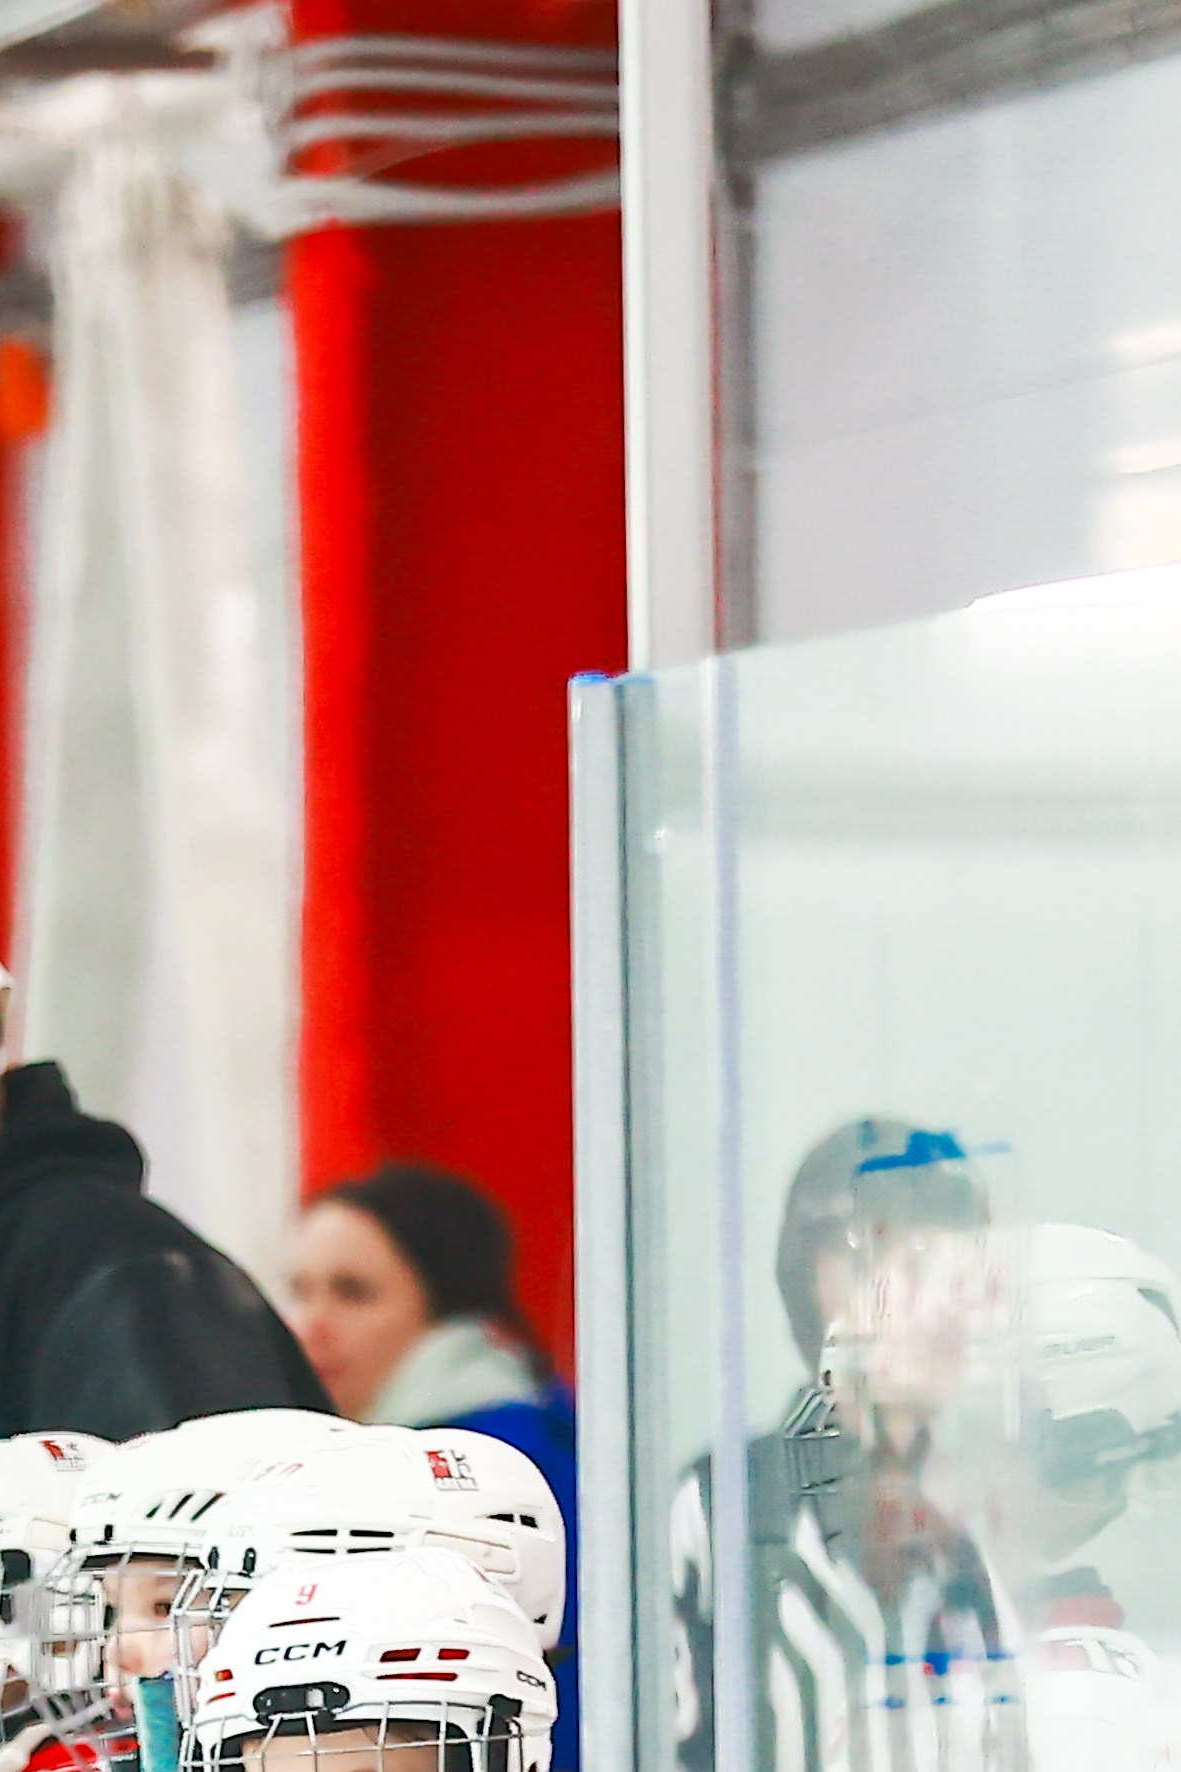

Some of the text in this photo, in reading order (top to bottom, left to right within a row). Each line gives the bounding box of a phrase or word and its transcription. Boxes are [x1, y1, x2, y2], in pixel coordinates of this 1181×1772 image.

[295, 1583, 318, 1606] 9
[253, 1639, 348, 1666] CCM
[516, 1670, 547, 1691] CCM
